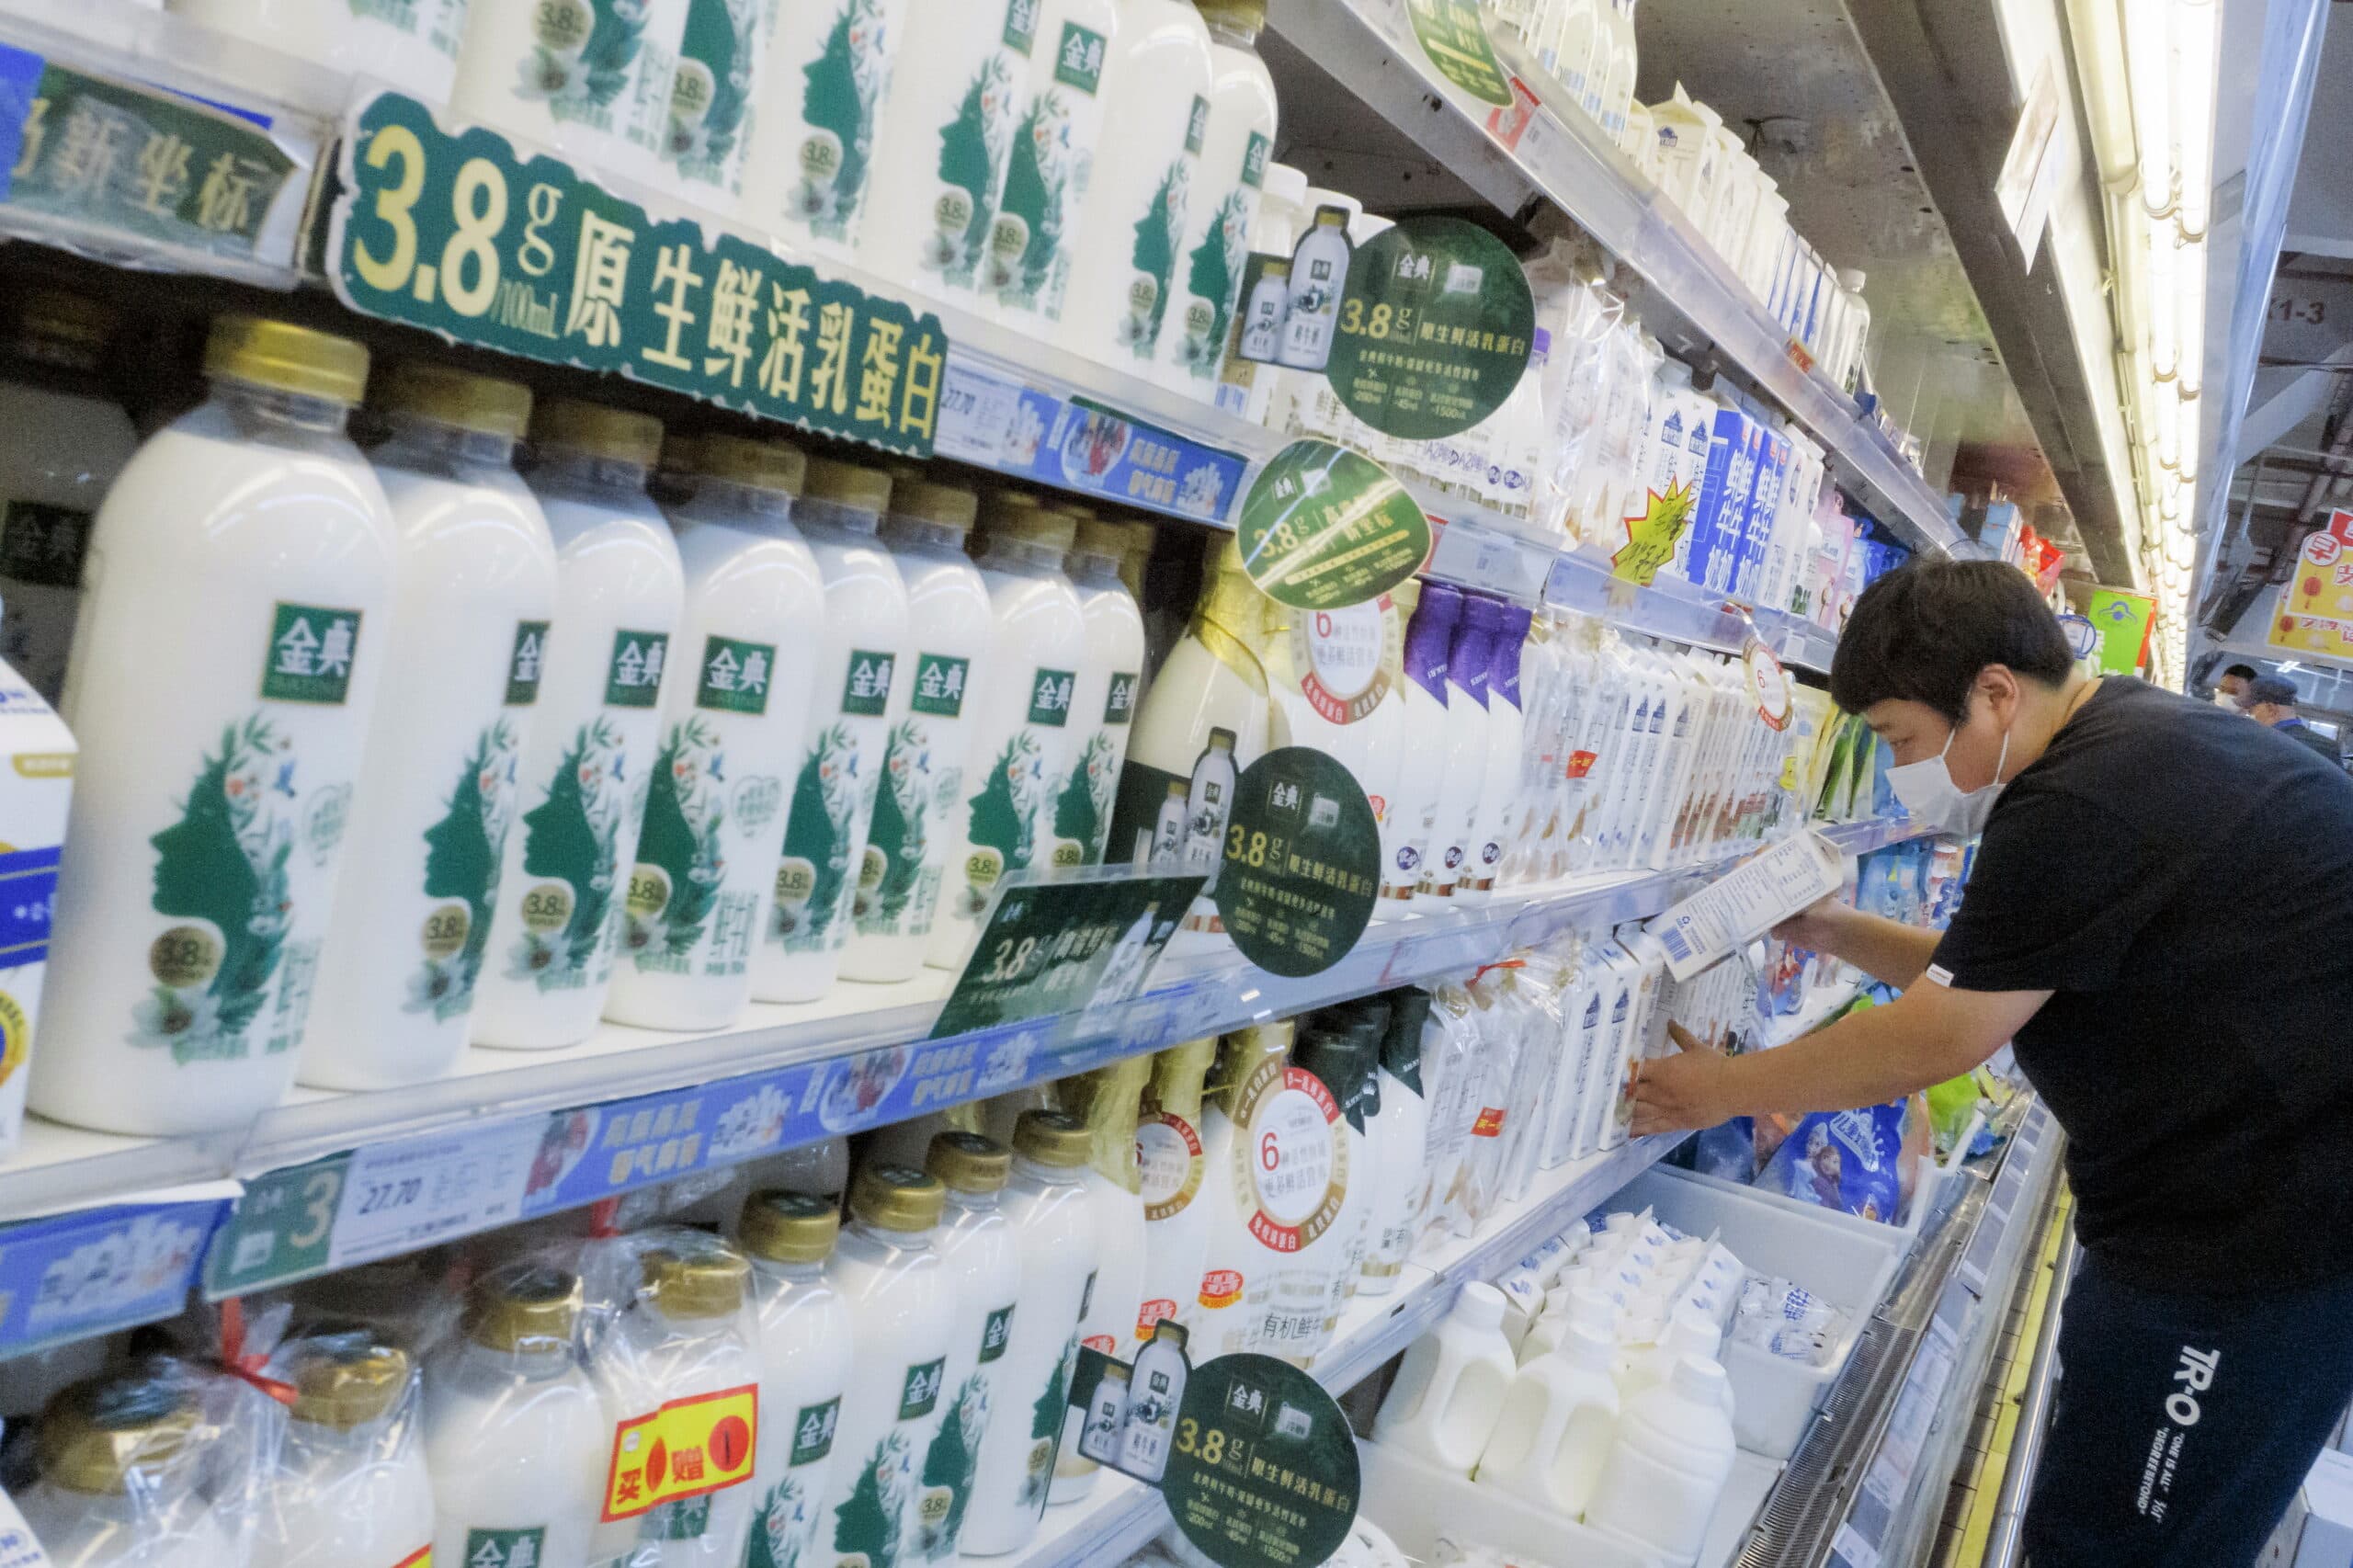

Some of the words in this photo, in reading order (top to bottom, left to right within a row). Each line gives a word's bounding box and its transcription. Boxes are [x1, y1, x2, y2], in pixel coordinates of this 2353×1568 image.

[1063, 33, 1103, 76] 金典
[353, 125, 508, 317] 3.8
[517, 182, 563, 276] g
[1397, 254, 1431, 279] 金典
[564, 208, 944, 439] 原生鲜活乳蛋白
[1340, 298, 1392, 339] 3.8
[1395, 308, 1413, 330] g
[276, 616, 352, 677] 金典
[514, 631, 543, 682] 金
[614, 639, 664, 687] 金典
[707, 647, 768, 695] 金典
[849, 658, 892, 699] 金典
[921, 661, 962, 700] 金典
[1035, 676, 1070, 710] 金典
[1226, 824, 1267, 868] 3.8
[1261, 1131, 1280, 1172] 6
[1231, 1383, 1263, 1415] 金典
[797, 1403, 838, 1450] 金典
[1176, 1418, 1225, 1464] 3.8
[616, 1467, 642, 1505] 买
[671, 1446, 704, 1484] 赠
